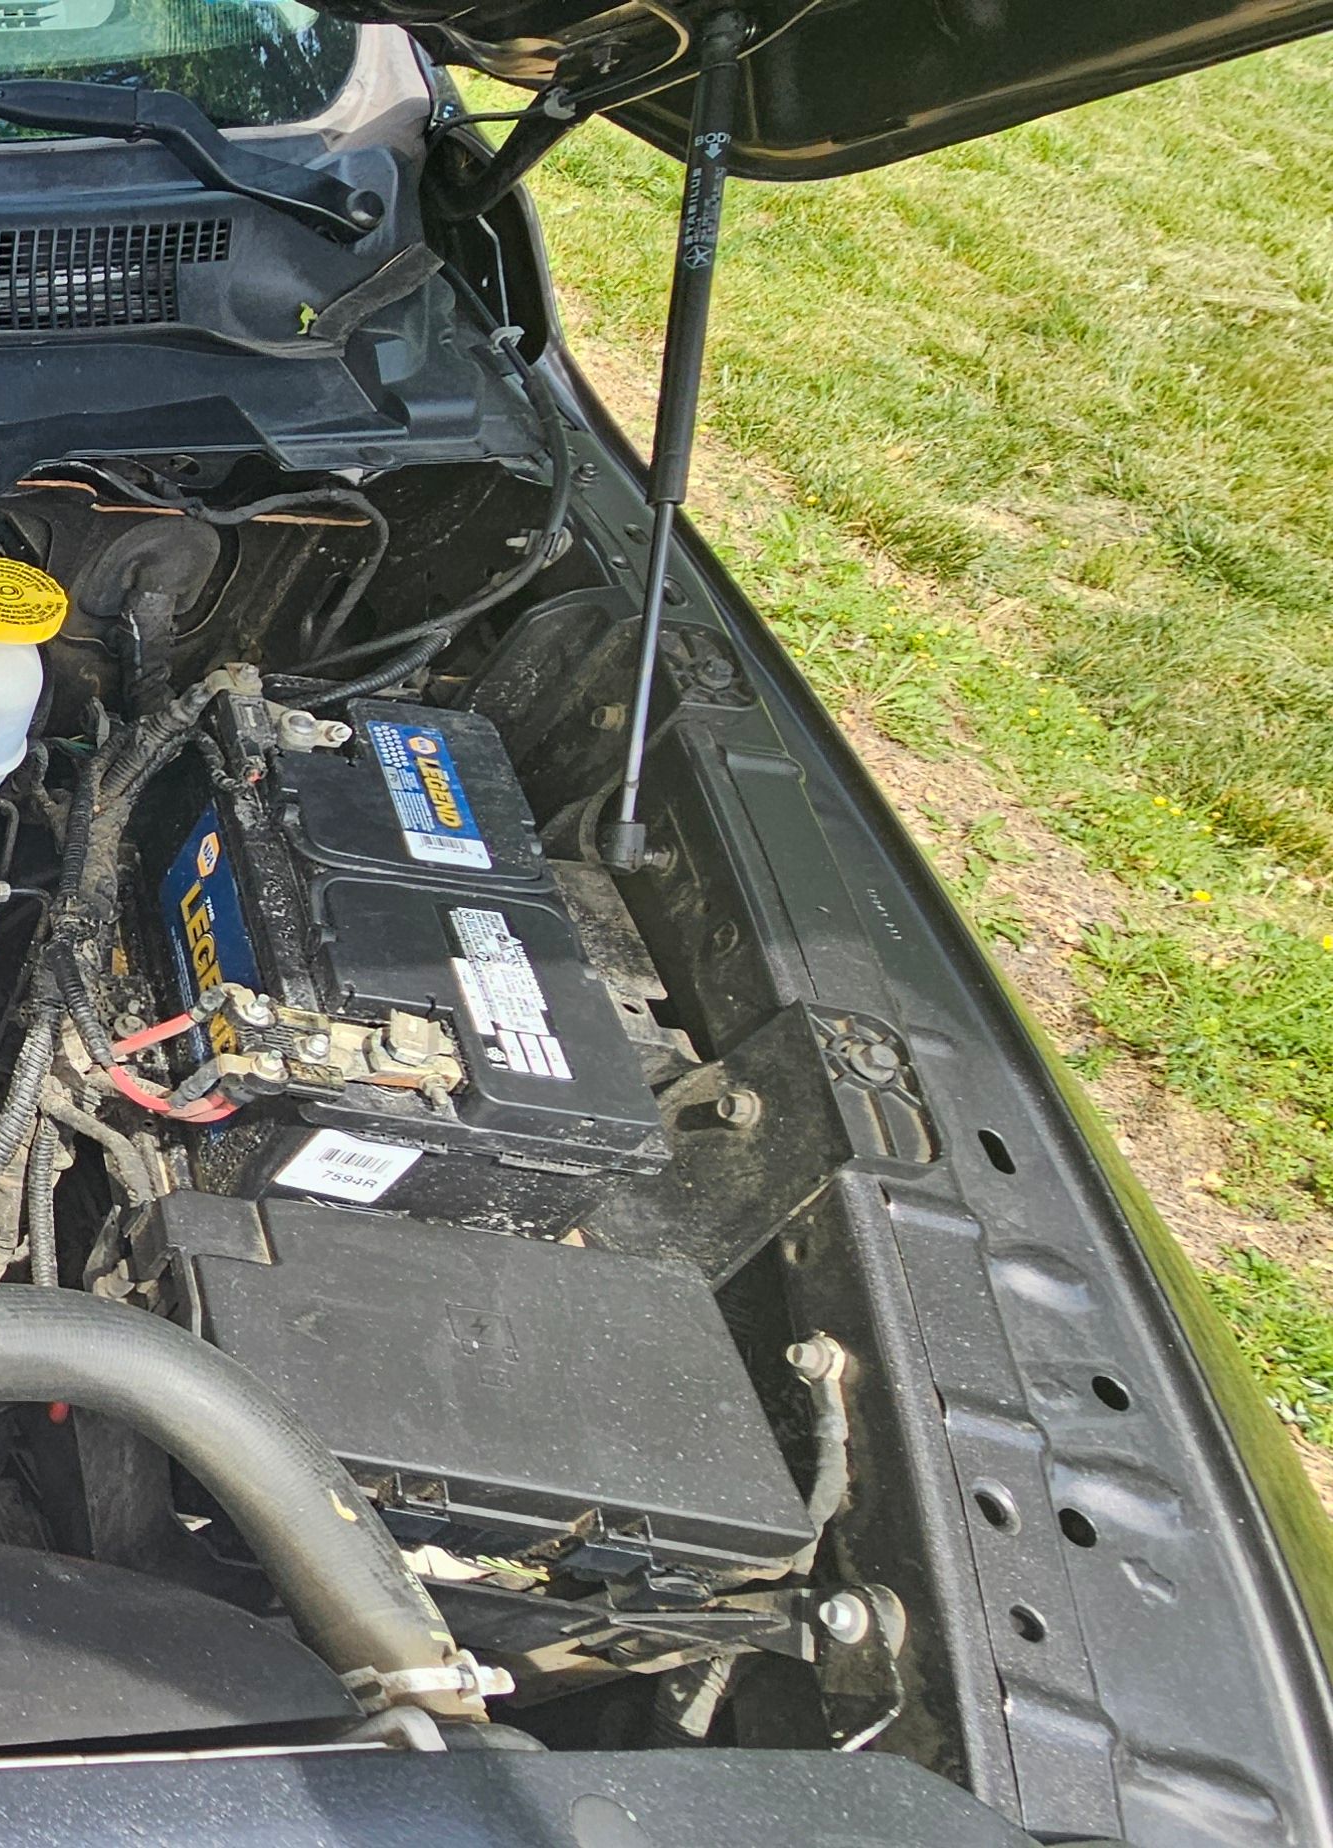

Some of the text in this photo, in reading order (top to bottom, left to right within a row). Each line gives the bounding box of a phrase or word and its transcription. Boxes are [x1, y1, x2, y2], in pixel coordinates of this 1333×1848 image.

[684, 167, 703, 245] STABILUS
[417, 756, 463, 828] LEGEND
[201, 895, 216, 921] THE
[321, 1169, 378, 1189] 7594R
